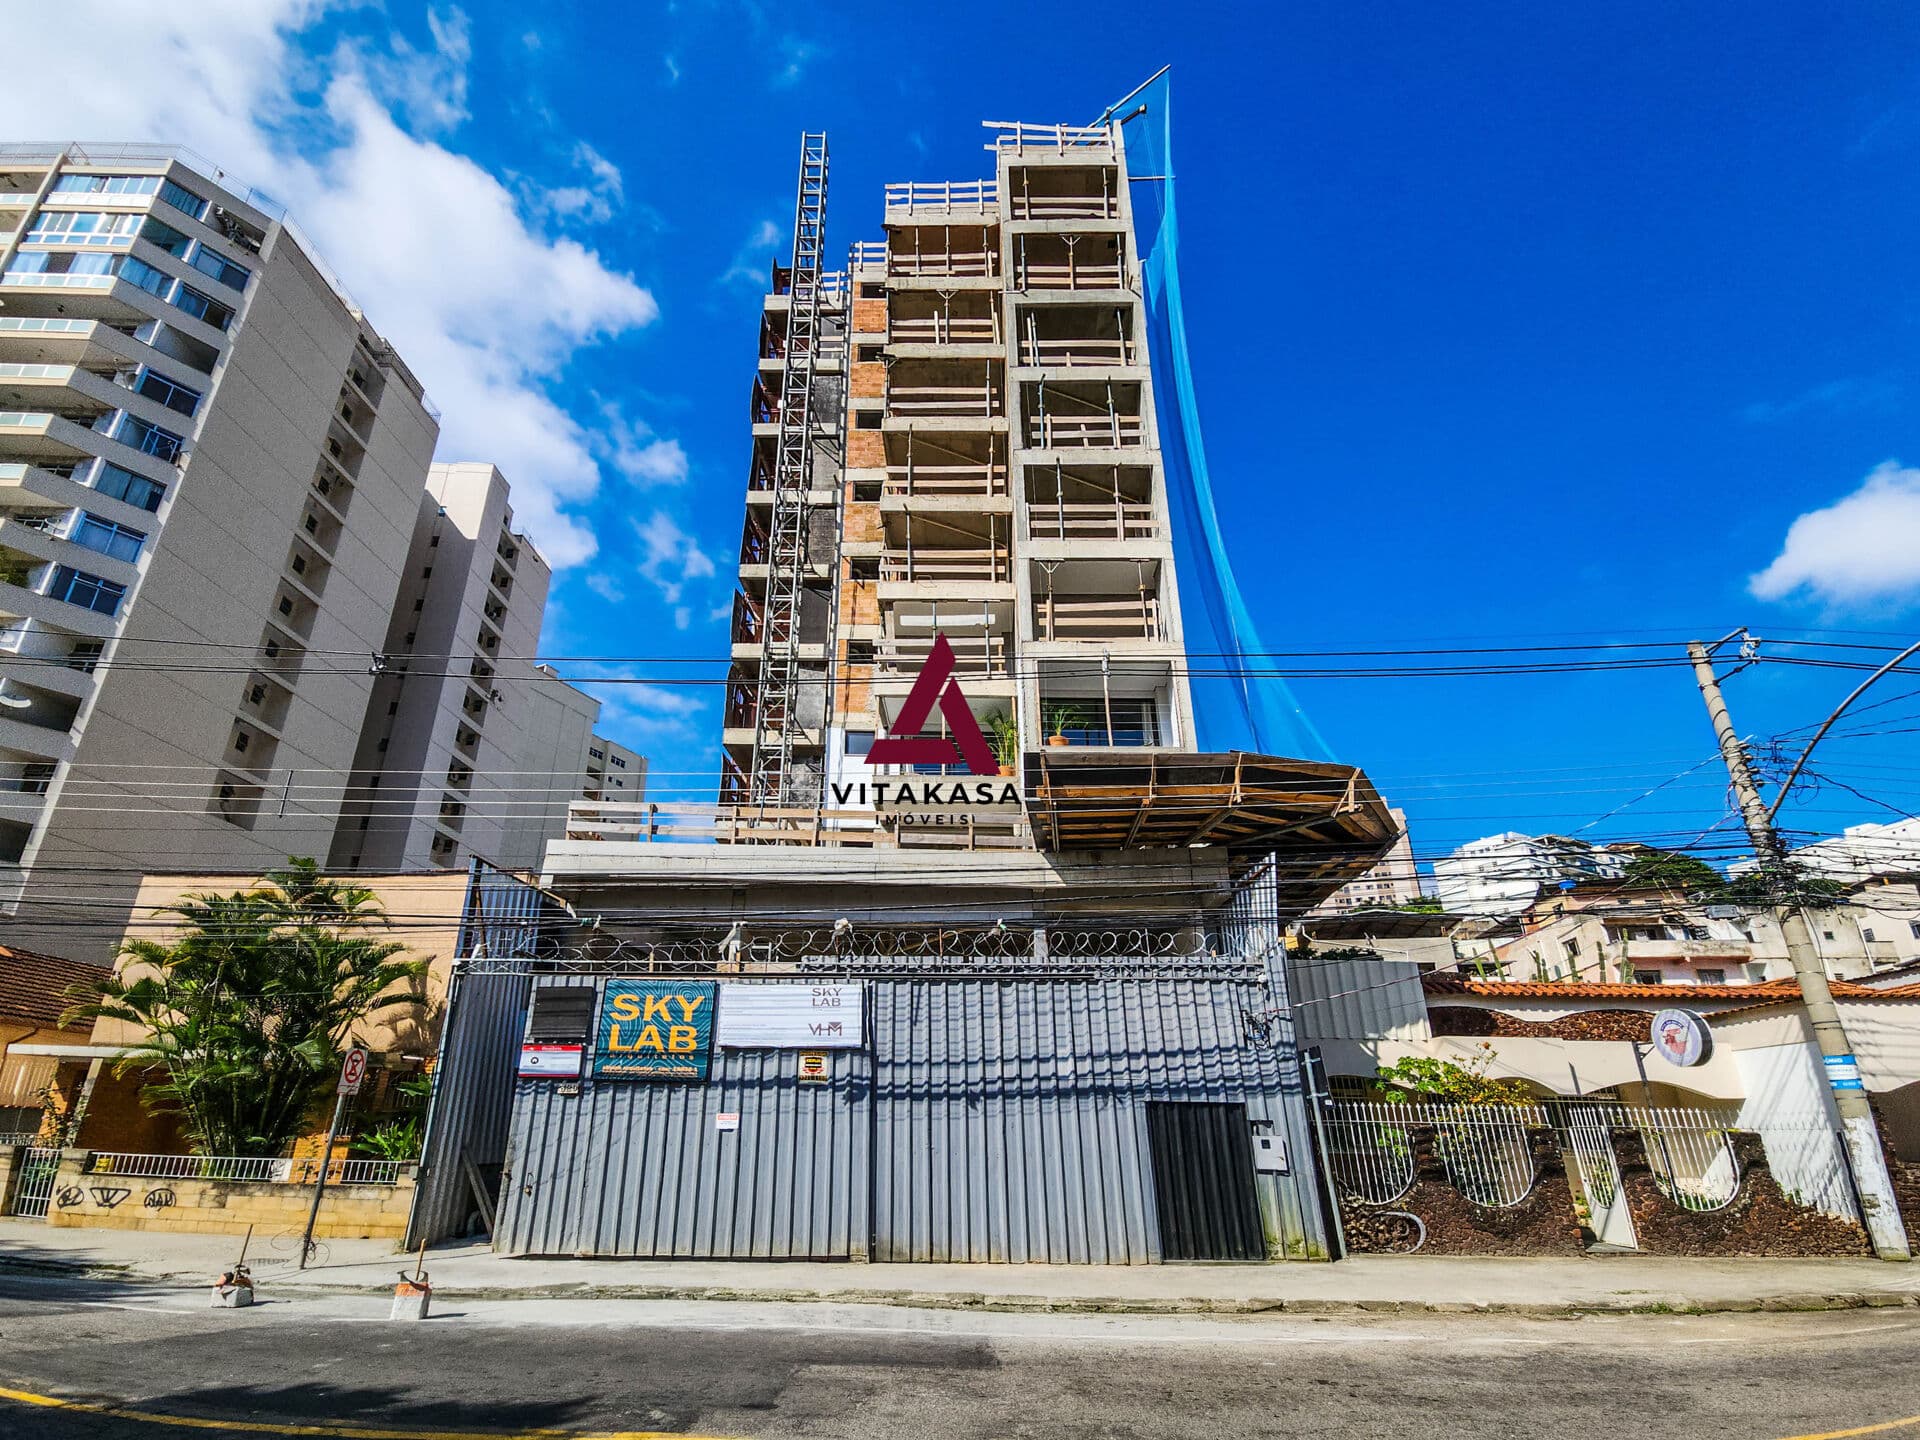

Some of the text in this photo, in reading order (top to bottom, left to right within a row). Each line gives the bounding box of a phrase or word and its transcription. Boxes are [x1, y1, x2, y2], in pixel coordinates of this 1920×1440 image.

[812, 988, 842, 997] SKY
[610, 993, 705, 1022] SKY
[812, 998, 841, 1007] LAB
[609, 1024, 698, 1053] LAB
